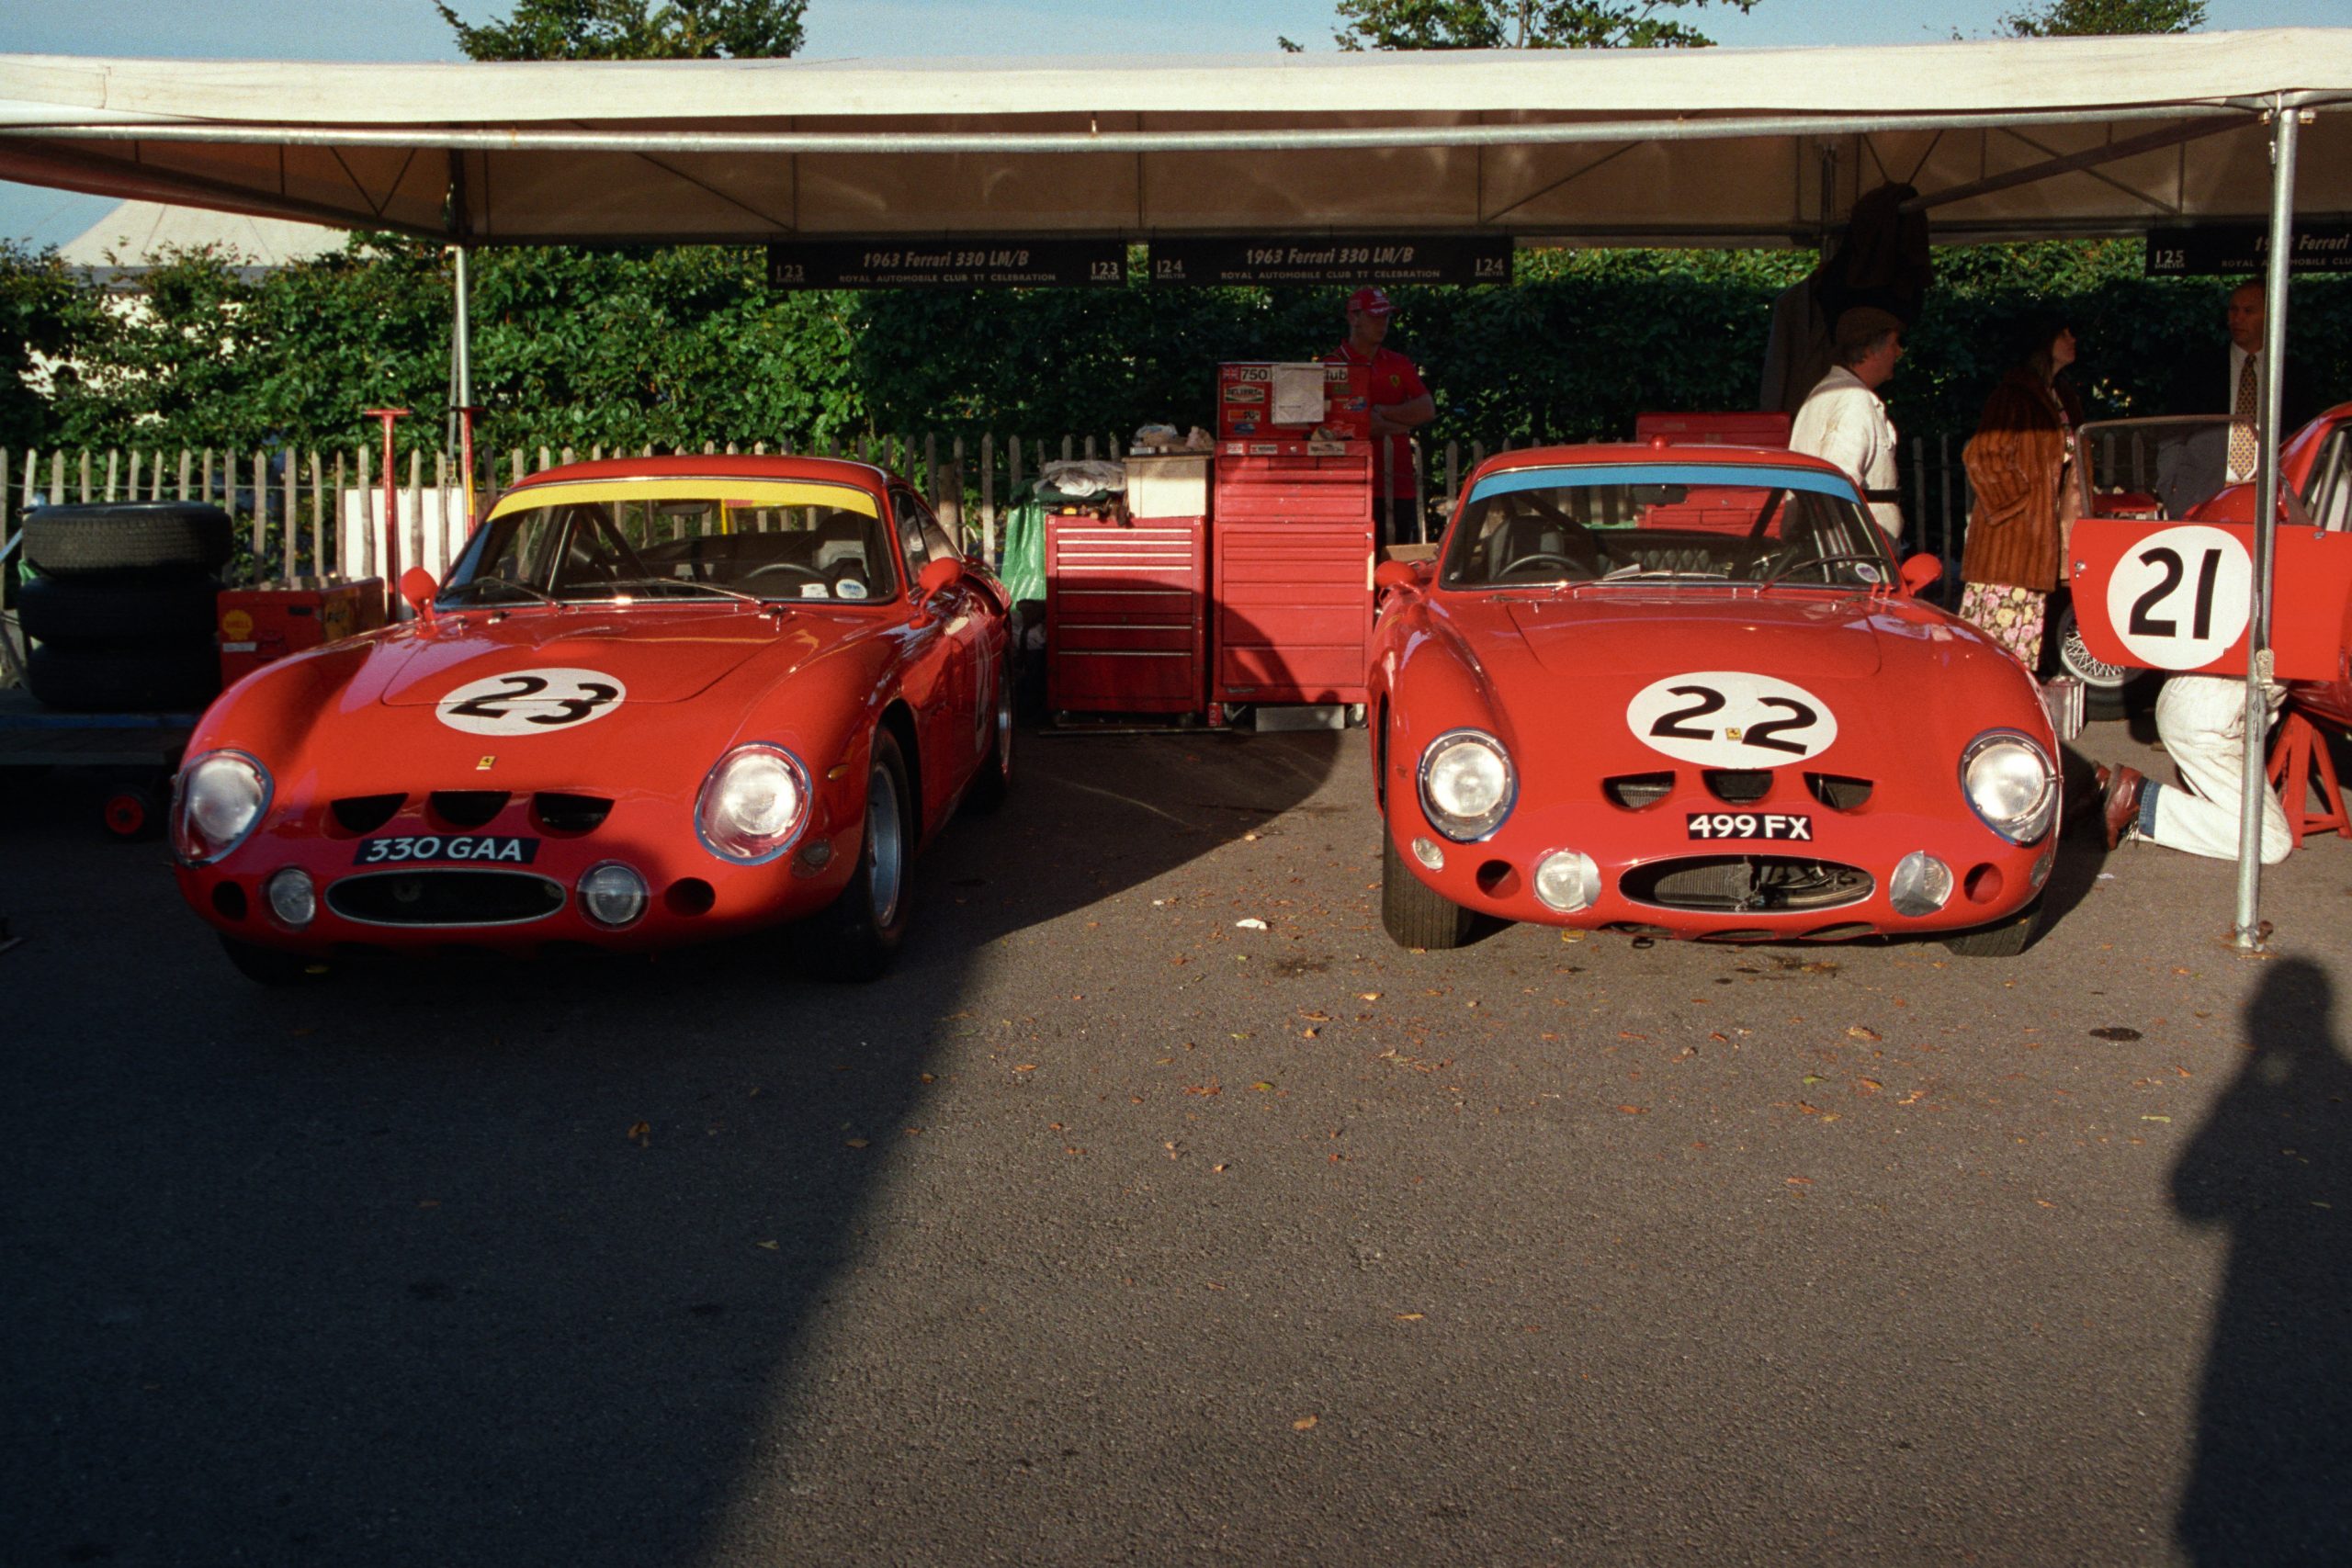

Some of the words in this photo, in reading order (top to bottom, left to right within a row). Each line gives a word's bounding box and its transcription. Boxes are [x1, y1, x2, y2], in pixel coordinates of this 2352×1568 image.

[2298, 232, 2351, 251] Ferrari
[863, 252, 900, 267] 1963
[904, 250, 952, 267] Ferrari
[955, 251, 985, 266] 330
[989, 249, 1030, 266] LM/B
[1246, 249, 1283, 265] 1963
[1287, 247, 1336, 265] Ferrari
[1339, 248, 1370, 263] 330
[1374, 246, 1415, 264] LM/B
[2155, 249, 2185, 263] 125
[1091, 262, 1119, 275] 123
[1157, 260, 1183, 273] 124
[1476, 258, 1504, 271] 124
[2222, 259, 2254, 267] ROYAL
[775, 265, 804, 277] 123
[838, 275, 871, 283] ROYAL
[876, 274, 938, 282] AUTOMOBILE
[943, 274, 967, 282] CLUB
[990, 273, 1056, 281] CELEBRATION
[1259, 271, 1321, 279] AUTOMOBILE
[1326, 270, 1351, 278] CLUB
[1357, 270, 1368, 278] TT
[1374, 269, 1441, 278] CELEBRATION
[1242, 368, 1267, 380] 750
[1326, 368, 1347, 380] lub
[2129, 547, 2222, 639] 21
[447, 675, 619, 725] 23
[1649, 685, 1817, 755] 22
[1689, 814, 1757, 838] 499
[1764, 815, 1811, 840] FX
[366, 837, 441, 863] 330
[447, 836, 522, 862] GAA
